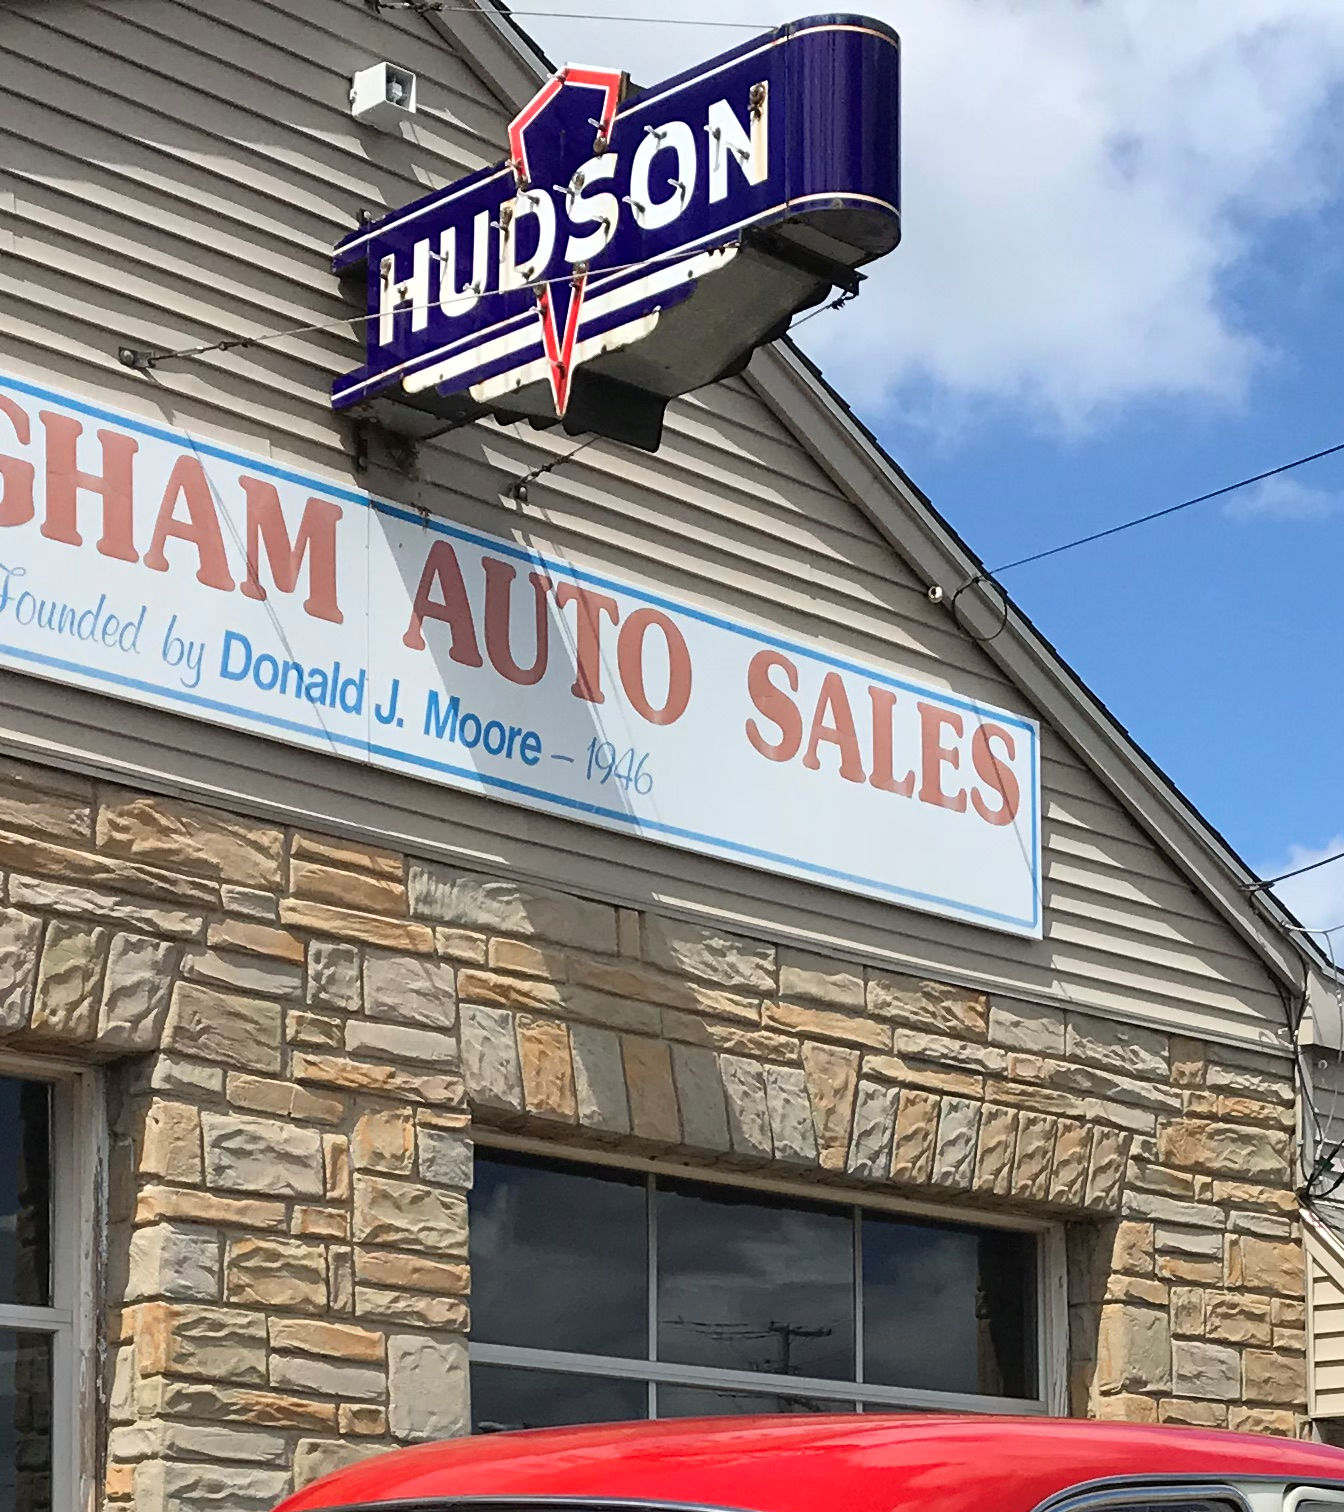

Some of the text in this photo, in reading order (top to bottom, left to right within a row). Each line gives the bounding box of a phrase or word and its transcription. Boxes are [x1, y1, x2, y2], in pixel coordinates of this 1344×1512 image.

[378, 80, 769, 347] HUDSON
[161, 614, 206, 689] by
[219, 629, 367, 717] Donald
[374, 678, 405, 728] J.
[423, 689, 543, 767] Moore
[586, 736, 653, 796] 1946
[402, 540, 694, 727] AUTO
[744, 649, 1024, 827] SALES
